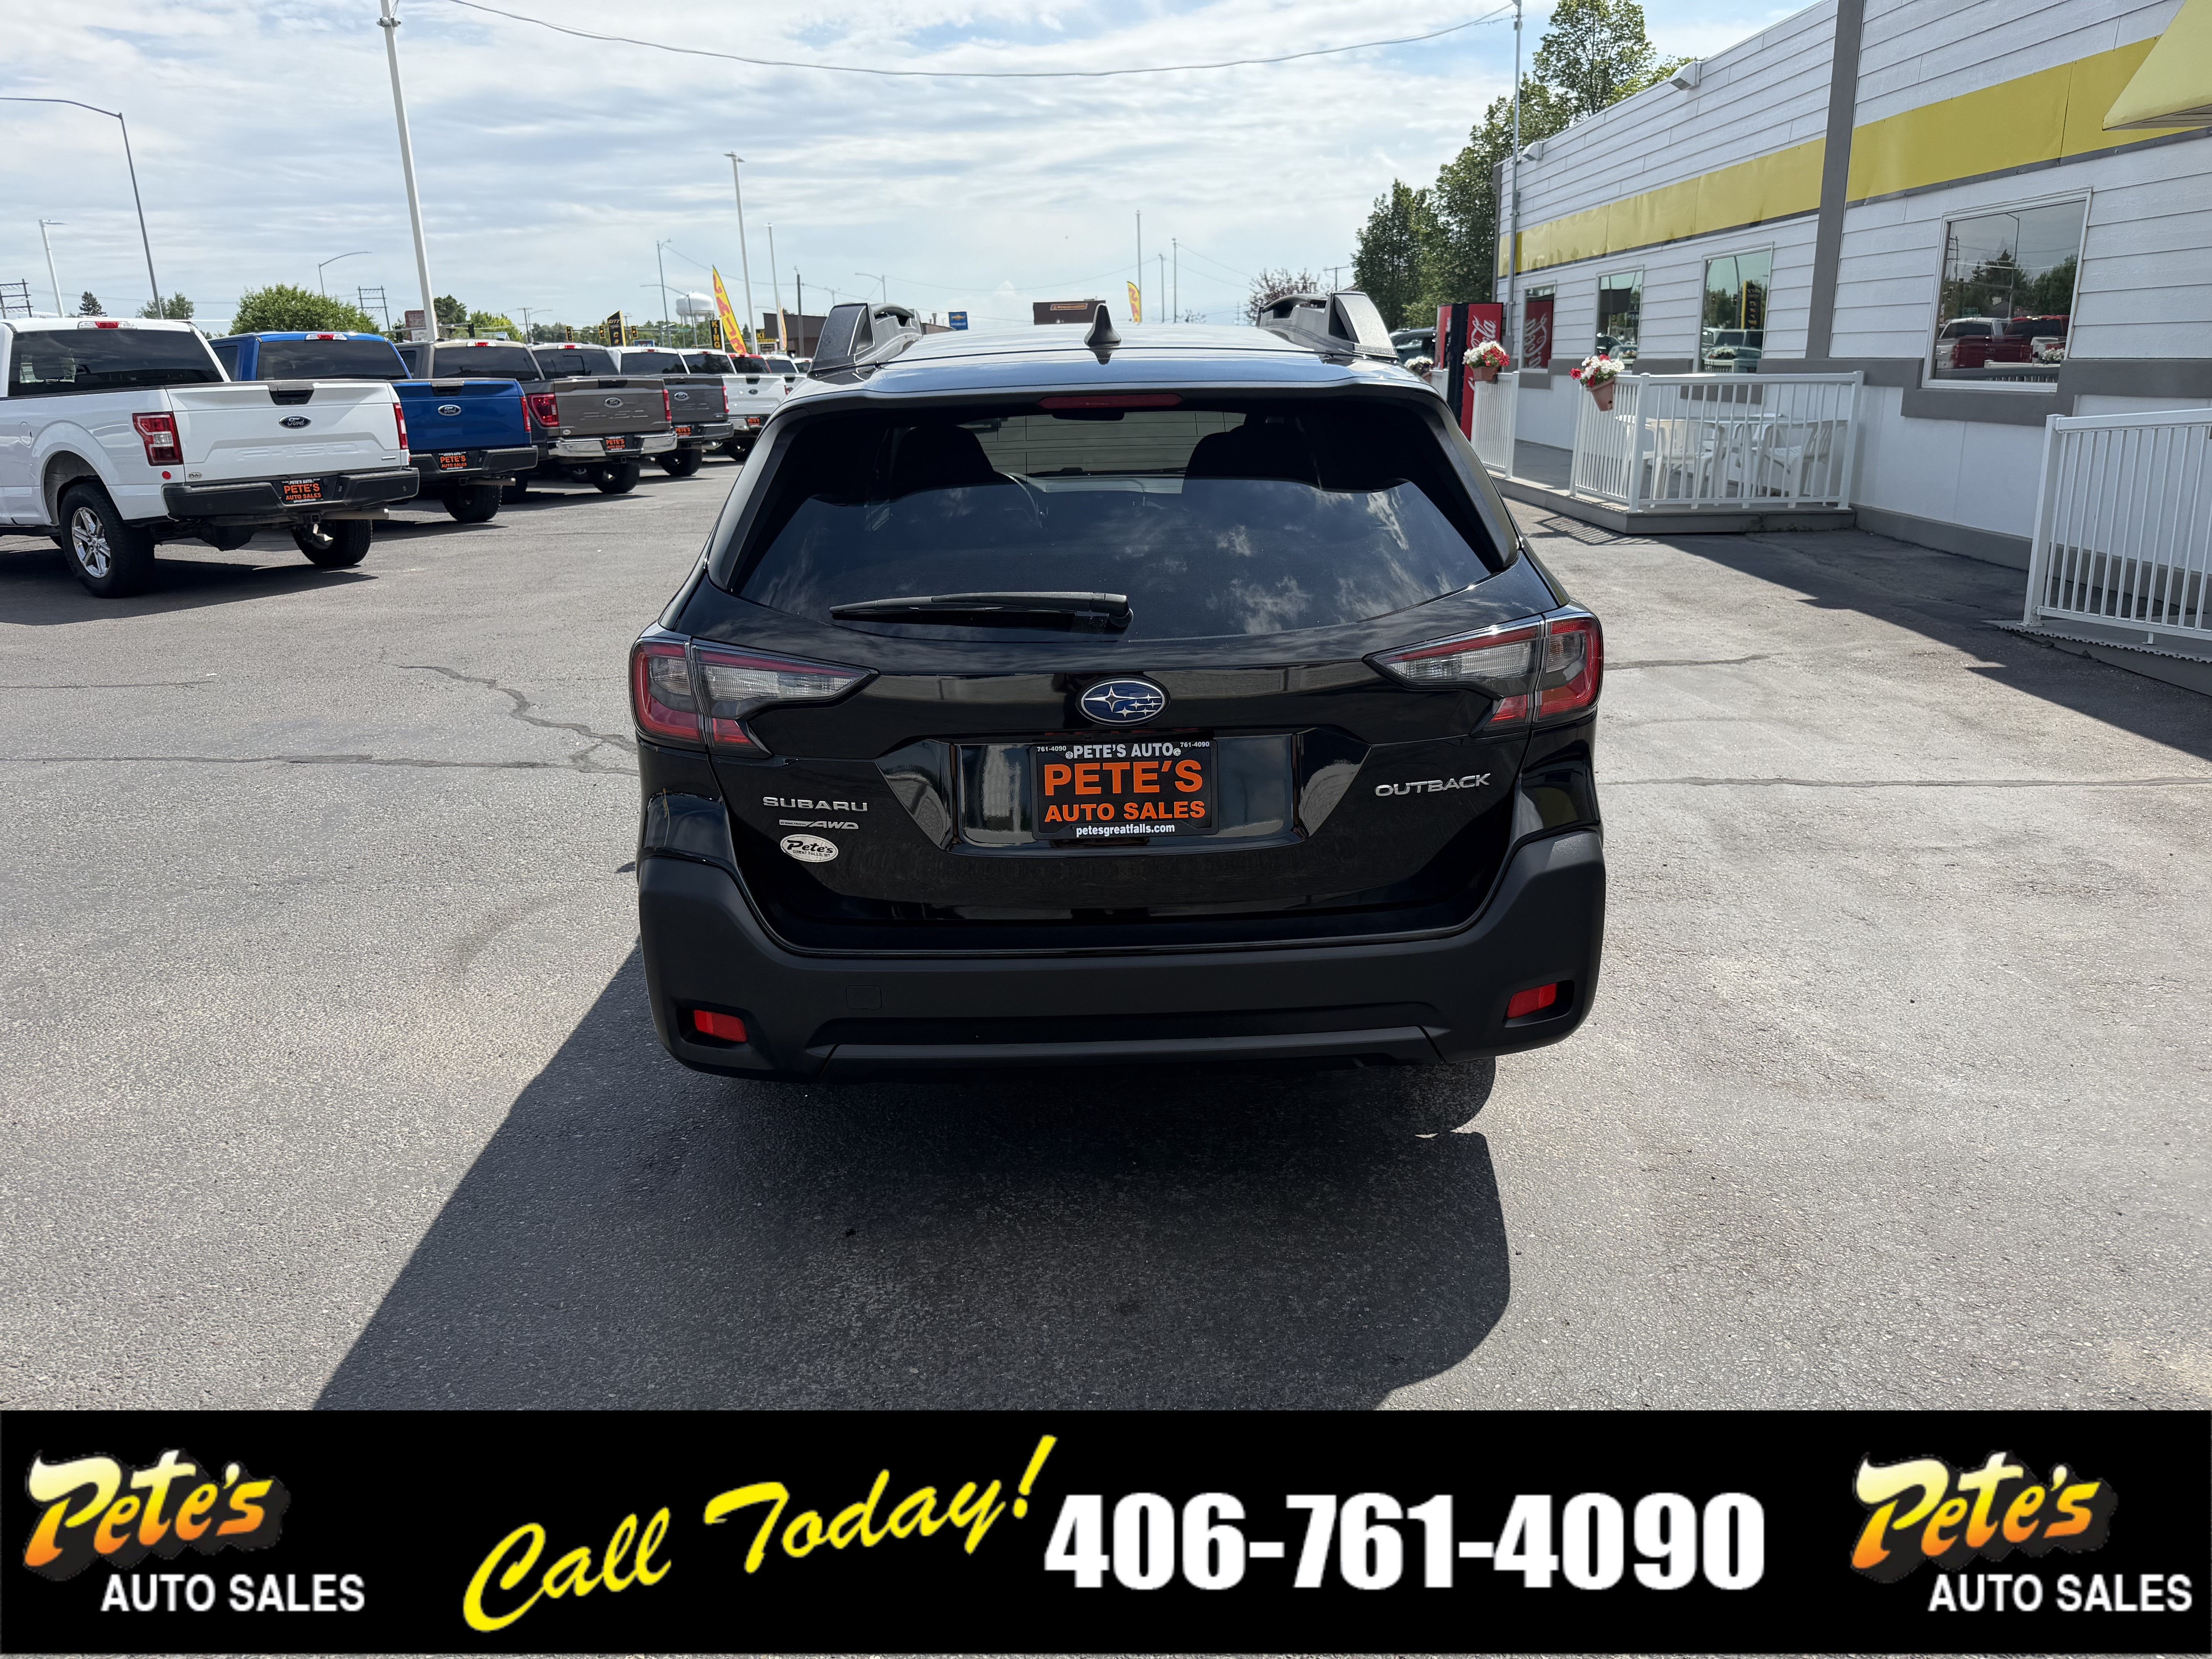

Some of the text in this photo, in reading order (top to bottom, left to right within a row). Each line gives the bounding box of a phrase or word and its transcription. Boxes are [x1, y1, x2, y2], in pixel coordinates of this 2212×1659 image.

[287, 417, 305, 426] Ford
[284, 483, 320, 494] PETE'S
[1073, 742, 1173, 759] PETE'S AUTO
[1044, 759, 1203, 796] PETE'S
[1375, 773, 1491, 796] OUTBACK
[763, 797, 867, 811] SUBARU
[1044, 800, 1206, 822] AUTO SALES
[809, 821, 859, 830] AWD
[1076, 823, 1175, 838] petesgreatfalls.com
[787, 840, 834, 853] Pete's
